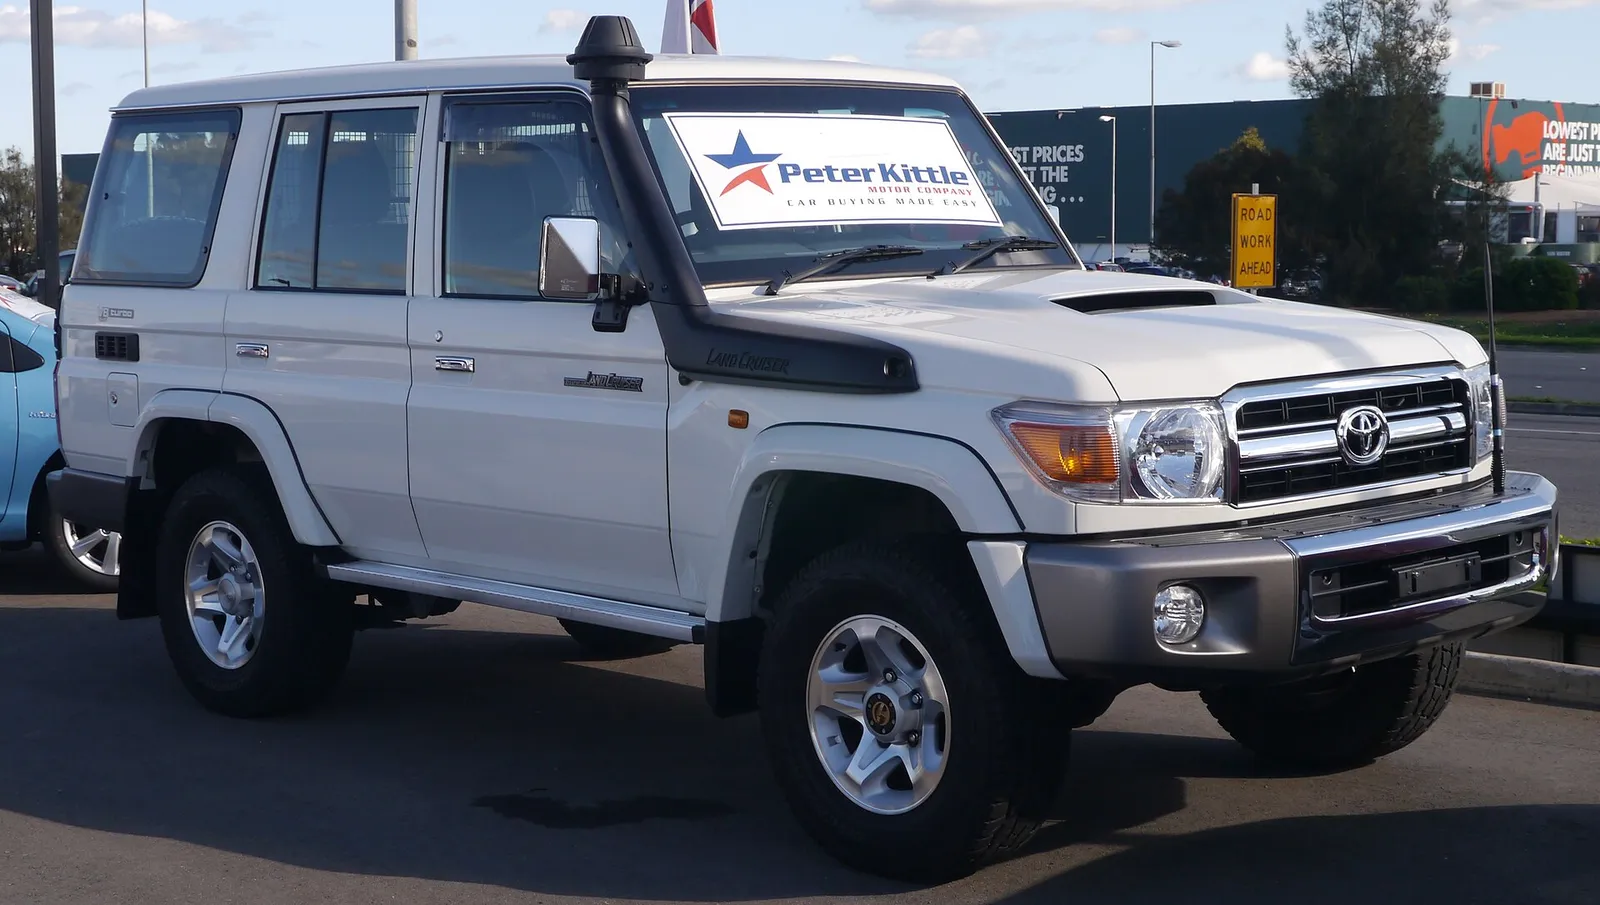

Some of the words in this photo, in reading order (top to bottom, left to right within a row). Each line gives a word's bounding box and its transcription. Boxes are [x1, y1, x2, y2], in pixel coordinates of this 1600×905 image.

[1543, 120, 1589, 140] LOWEST
[1032, 144, 1084, 163] PRICES
[1543, 143, 1566, 160] ARE
[1567, 144, 1595, 162] JUST
[778, 163, 876, 183] Peter
[878, 163, 969, 186] Kittle
[1040, 165, 1069, 183] THE
[917, 186, 973, 196] COMPANY
[827, 198, 886, 206] BUYING
[943, 199, 977, 207] EASY
[1240, 207, 1272, 221] ROAD
[1240, 234, 1271, 248] WORK
[1240, 261, 1271, 275] AHEAD
